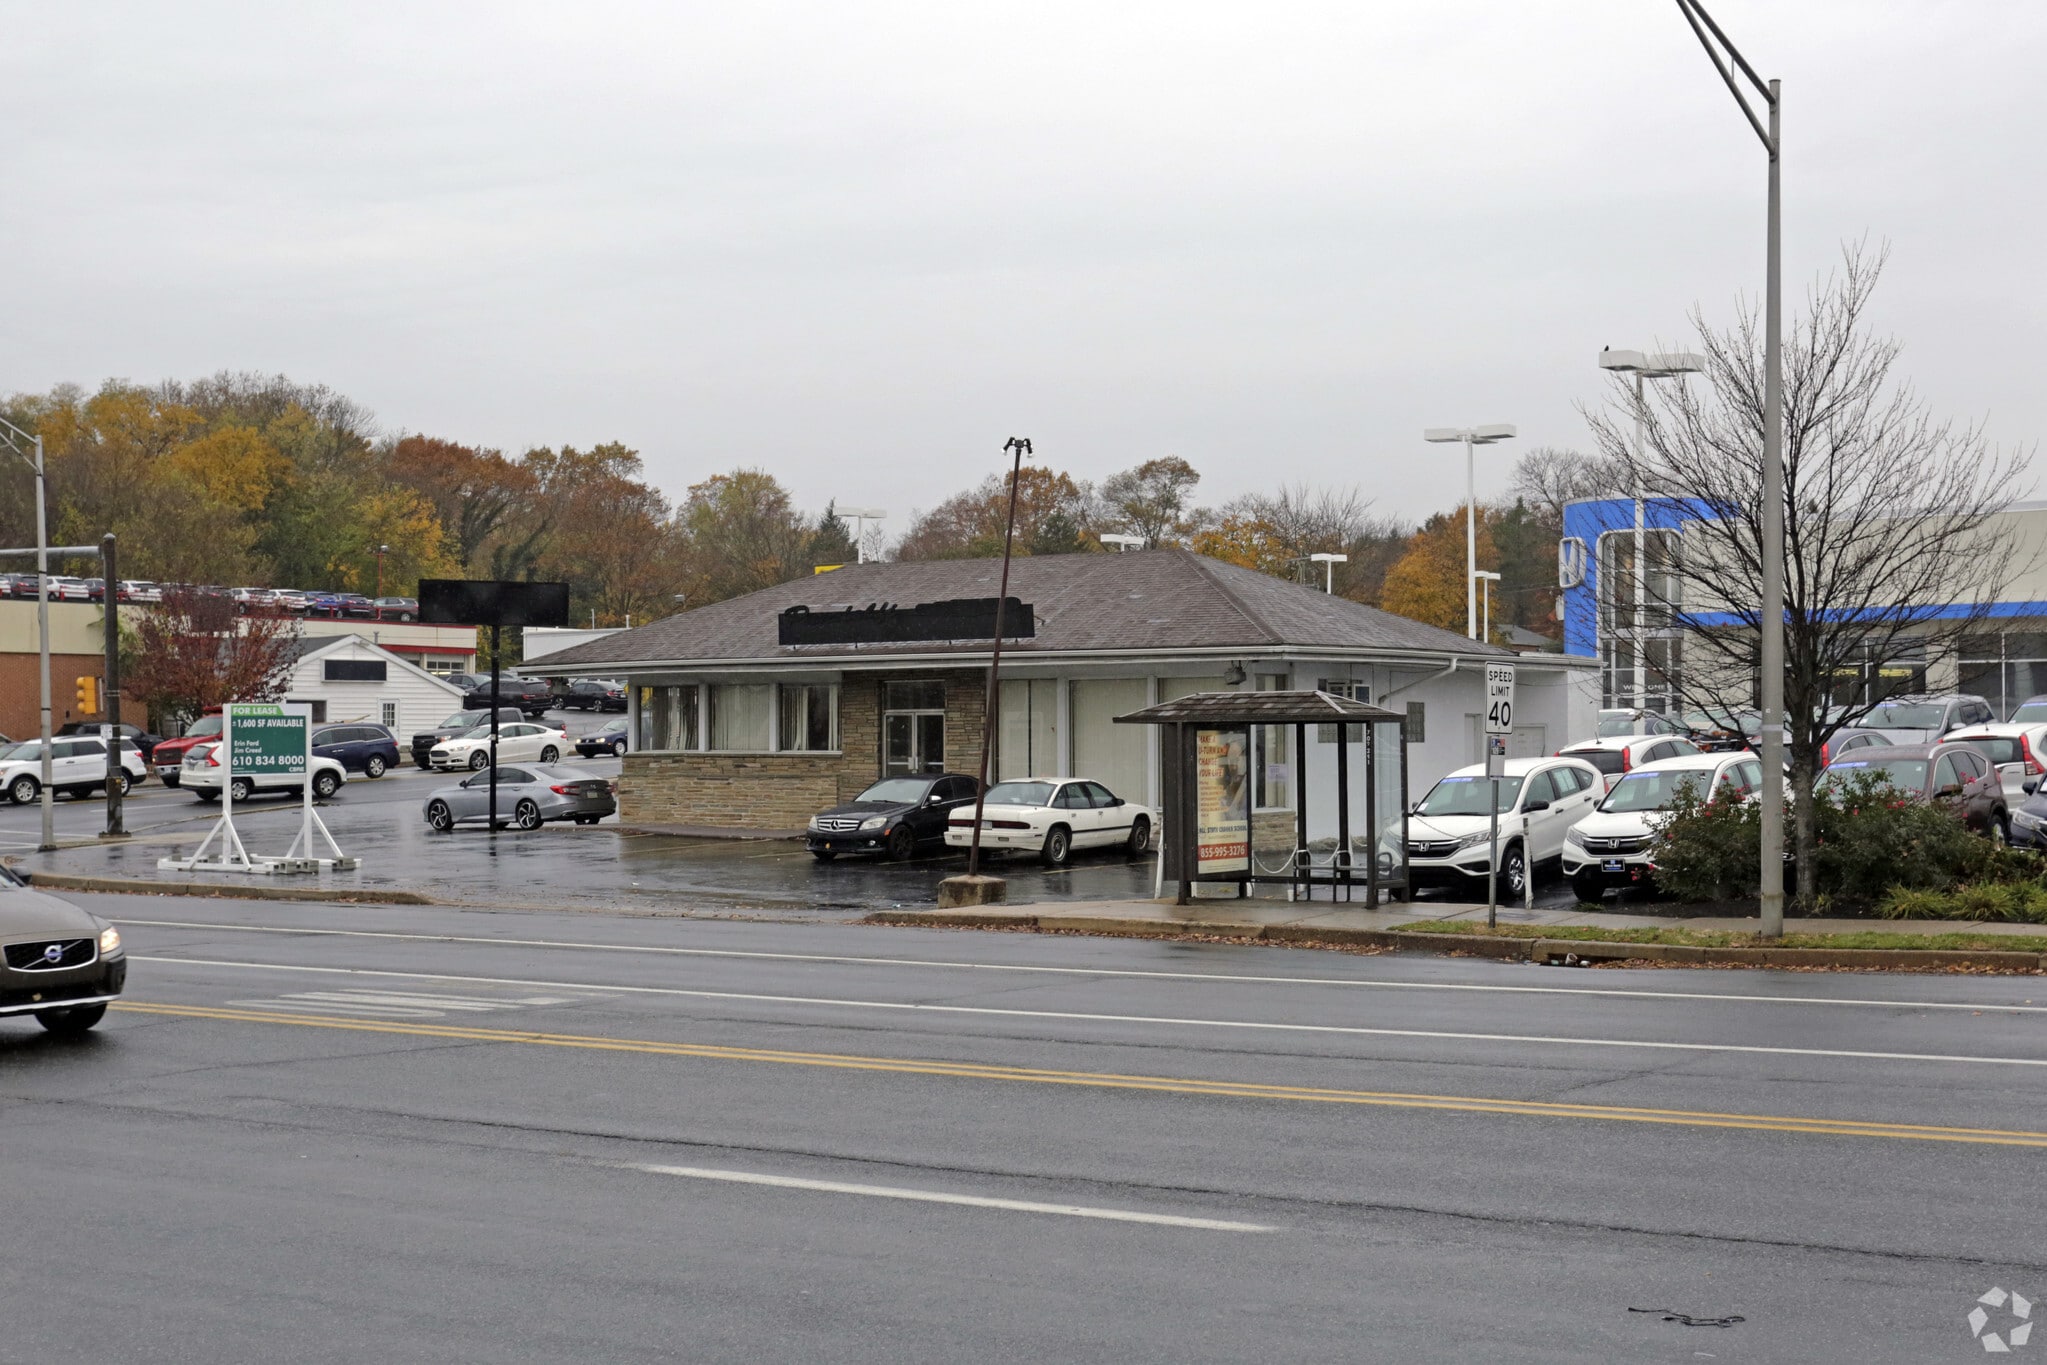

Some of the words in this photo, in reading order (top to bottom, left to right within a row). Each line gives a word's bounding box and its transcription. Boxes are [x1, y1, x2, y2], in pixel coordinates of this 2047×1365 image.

[1488, 670, 1513, 683] SPEED
[1490, 686, 1510, 697] LIMIT
[232, 707, 251, 715] FOR
[252, 707, 278, 715] LEASE
[1488, 701, 1511, 727] 40
[257, 719, 266, 728] SF
[266, 719, 304, 728] AVAILABLE
[232, 756, 253, 766] 610
[255, 756, 275, 765] 834
[278, 755, 305, 765] 8000
[1211, 767, 1224, 777] LIFE
[1200, 845, 1245, 858] 855-995-3276
